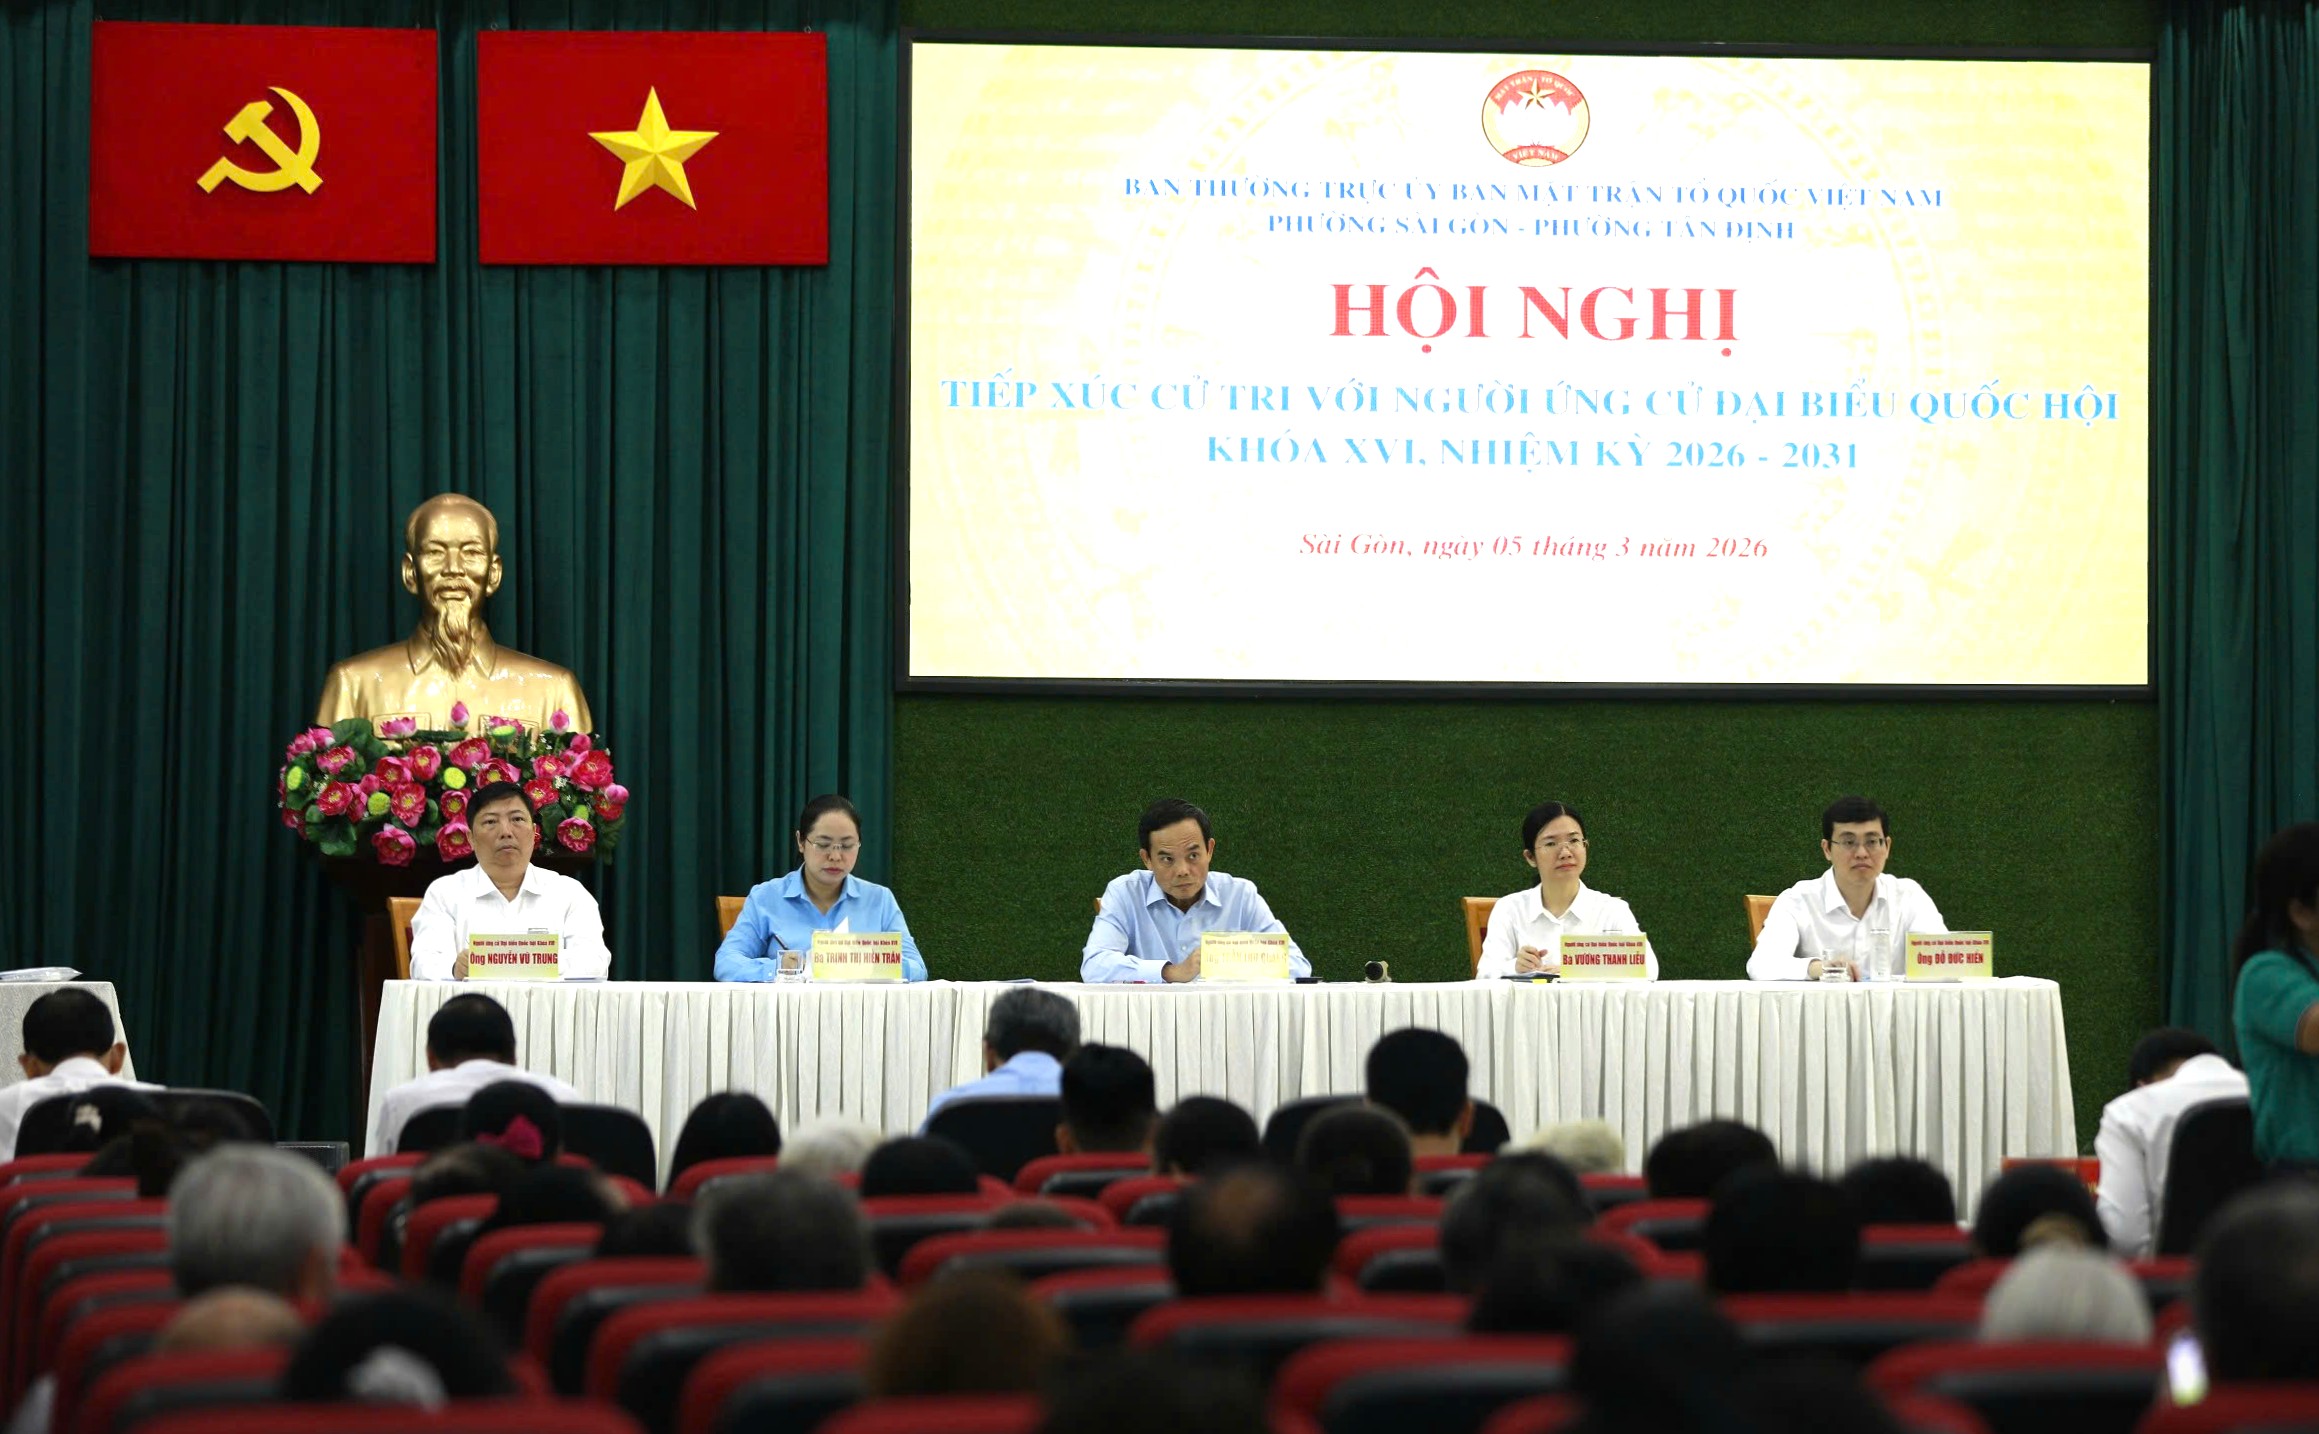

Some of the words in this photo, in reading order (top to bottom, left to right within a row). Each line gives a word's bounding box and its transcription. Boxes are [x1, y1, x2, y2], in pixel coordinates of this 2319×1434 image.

[1538, 150, 1558, 159] NAM
[1126, 179, 1179, 196] BAN
[1190, 175, 1309, 197] THƯỜNG
[1320, 180, 1395, 204] TRỰC
[1453, 184, 1506, 200] BAN
[1587, 181, 1661, 208] TRẬN
[1673, 178, 1709, 203] TỔ
[1718, 179, 1796, 208] QUỐC
[1808, 183, 1870, 210] VIỆT
[1881, 189, 1941, 206] NAM
[1269, 211, 1385, 233] PHƯỜNG
[1396, 212, 1437, 233] SÀI
[1449, 213, 1507, 234] GÒN
[1536, 215, 1650, 236] PHƯỜNG
[1660, 216, 1715, 237] TÂN
[1727, 222, 1793, 243] ĐỊNH
[1331, 267, 1488, 353] HỘI
[1520, 286, 1737, 357] NGHỊ
[941, 368, 1037, 408] TIẾP
[1051, 374, 1136, 409] XÚC
[1151, 375, 1209, 410] CỬ
[1221, 385, 1289, 411] TRI
[1308, 378, 1378, 412] VỚI
[1396, 382, 1528, 414] NGƯỜI
[1546, 380, 1629, 415] ỨNG
[1646, 384, 1703, 415] CỬ
[1717, 390, 1784, 423] ĐẠI
[1802, 378, 1894, 418] BIỂU
[1910, 380, 2028, 424] QUỐC
[2044, 384, 2117, 426] HỘI
[1209, 430, 1327, 463] KHÓA
[1344, 438, 1426, 465] XVI,
[1441, 432, 1578, 473] NHIỆM
[1596, 433, 1650, 466] KỲ
[1666, 441, 1745, 468] 2026
[1782, 442, 1856, 469] 2031
[1299, 533, 1341, 555] Sài
[1351, 533, 1412, 557] Gòn,
[1423, 536, 1484, 560] ngày
[1493, 536, 1522, 556] 05
[1533, 536, 1607, 561] tháng
[1616, 537, 1630, 557] 3
[1641, 537, 1695, 558] năm
[1706, 537, 1768, 558] 2026
[470, 952, 485, 965] Ông
[488, 950, 517, 964] NGUYỄN
[520, 952, 530, 964] VŨ
[533, 953, 557, 964] TRUNG
[827, 953, 847, 965] TRỊNH
[850, 953, 861, 965] THỊ
[1603, 954, 1627, 965] THANH
[1917, 951, 1932, 965] Ông
